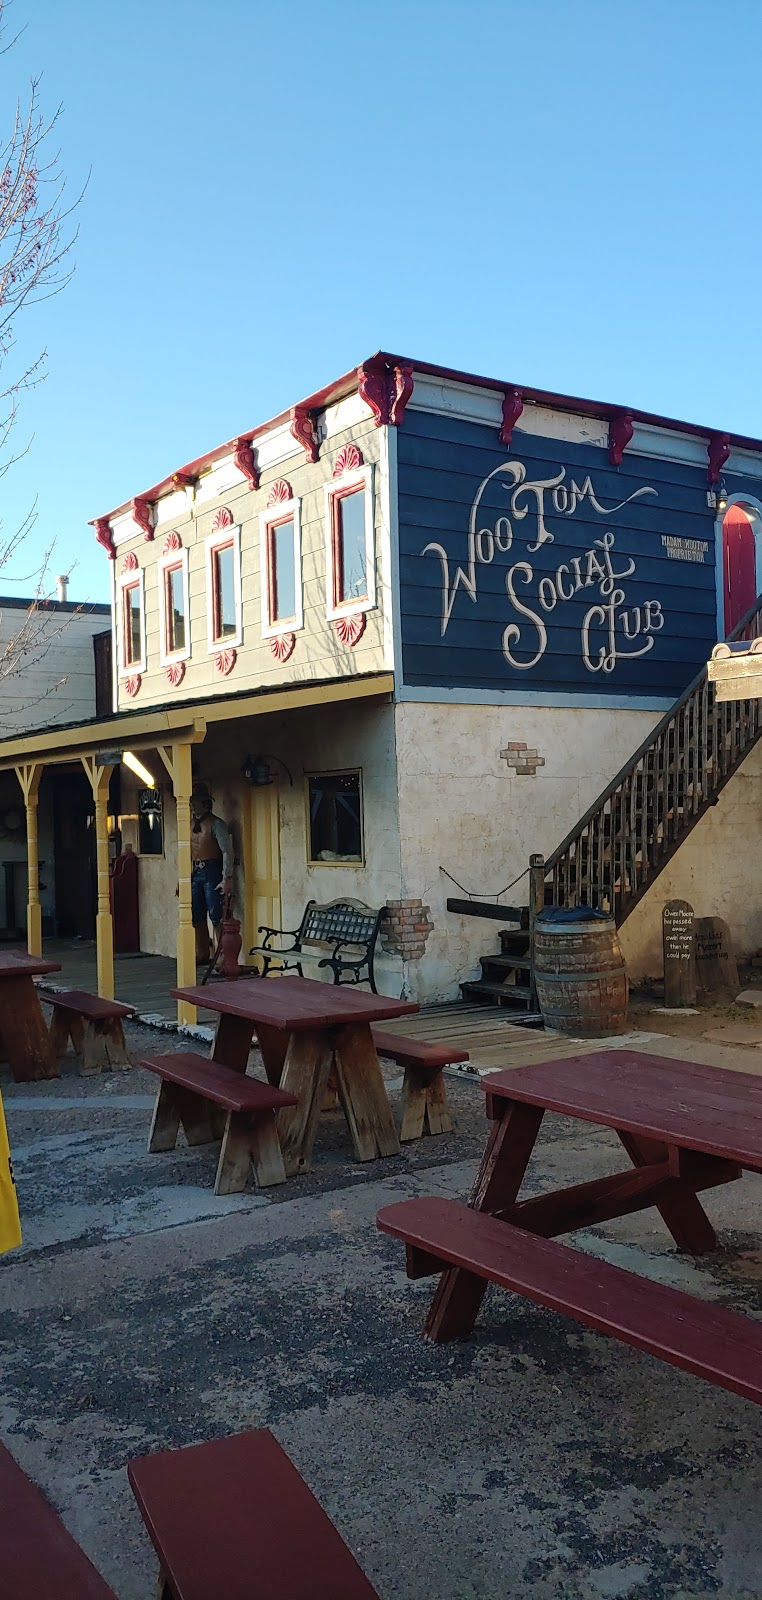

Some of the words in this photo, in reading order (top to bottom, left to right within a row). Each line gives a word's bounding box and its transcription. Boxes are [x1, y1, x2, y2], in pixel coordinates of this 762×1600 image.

[661, 535, 682, 548] MADAM
[666, 547, 705, 563] PROPRIETOR
[502, 532, 636, 670] SOCIAL
[581, 588, 665, 673] CLUB
[664, 908, 679, 917] Owen
[679, 909, 694, 917] Moore
[672, 918, 692, 926] passed
[666, 951, 680, 959] could
